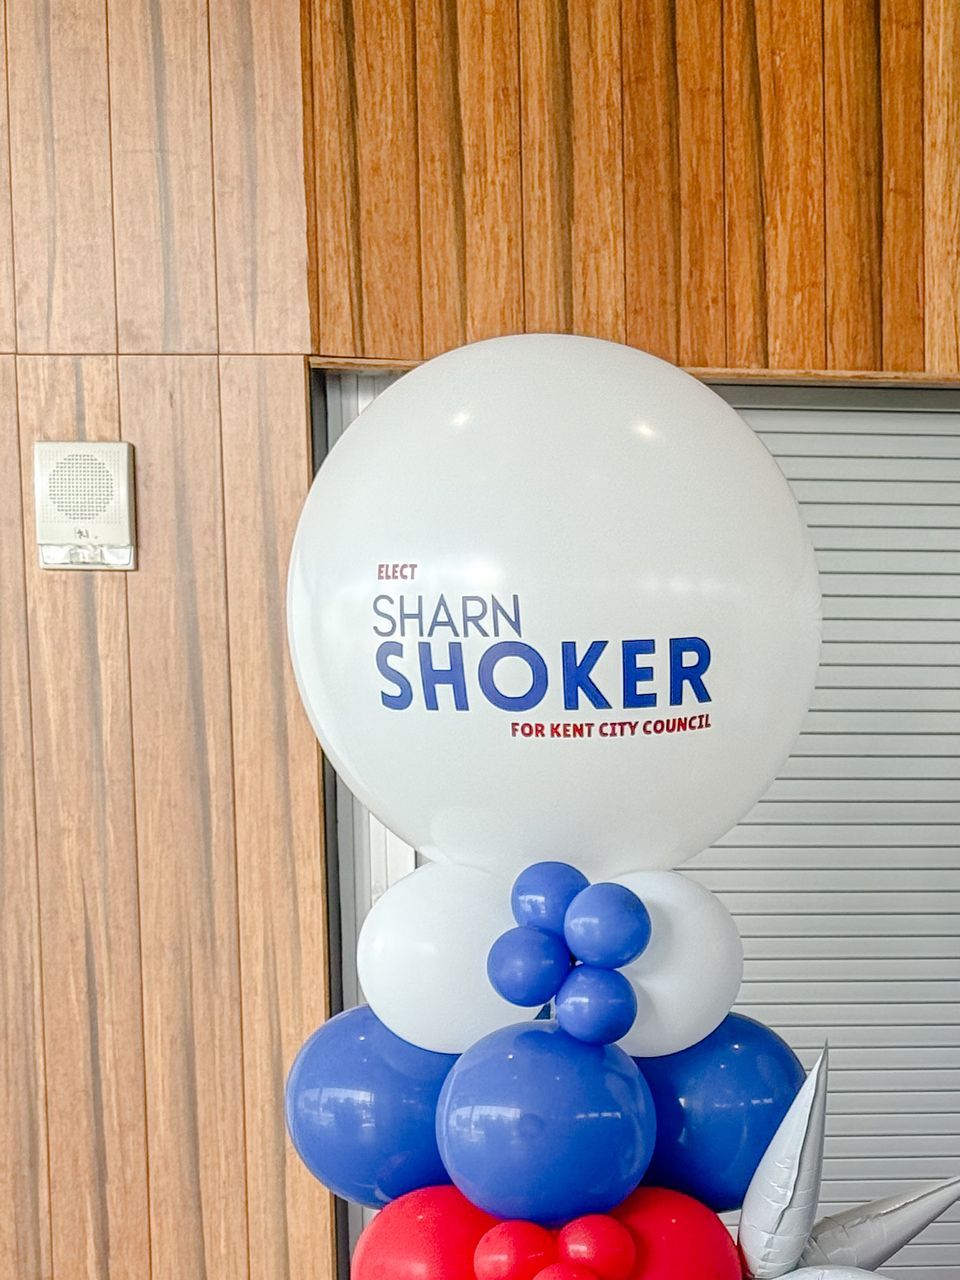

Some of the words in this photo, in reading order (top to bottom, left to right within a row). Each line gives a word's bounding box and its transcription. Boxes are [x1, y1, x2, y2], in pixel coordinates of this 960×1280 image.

[377, 563, 418, 580] ELECT
[372, 593, 523, 638] SHARN
[375, 636, 712, 712] SHOKER
[511, 721, 545, 738] FOR
[550, 721, 595, 738] KENT
[598, 720, 639, 737] CITY
[642, 713, 712, 735] COUNCIL
